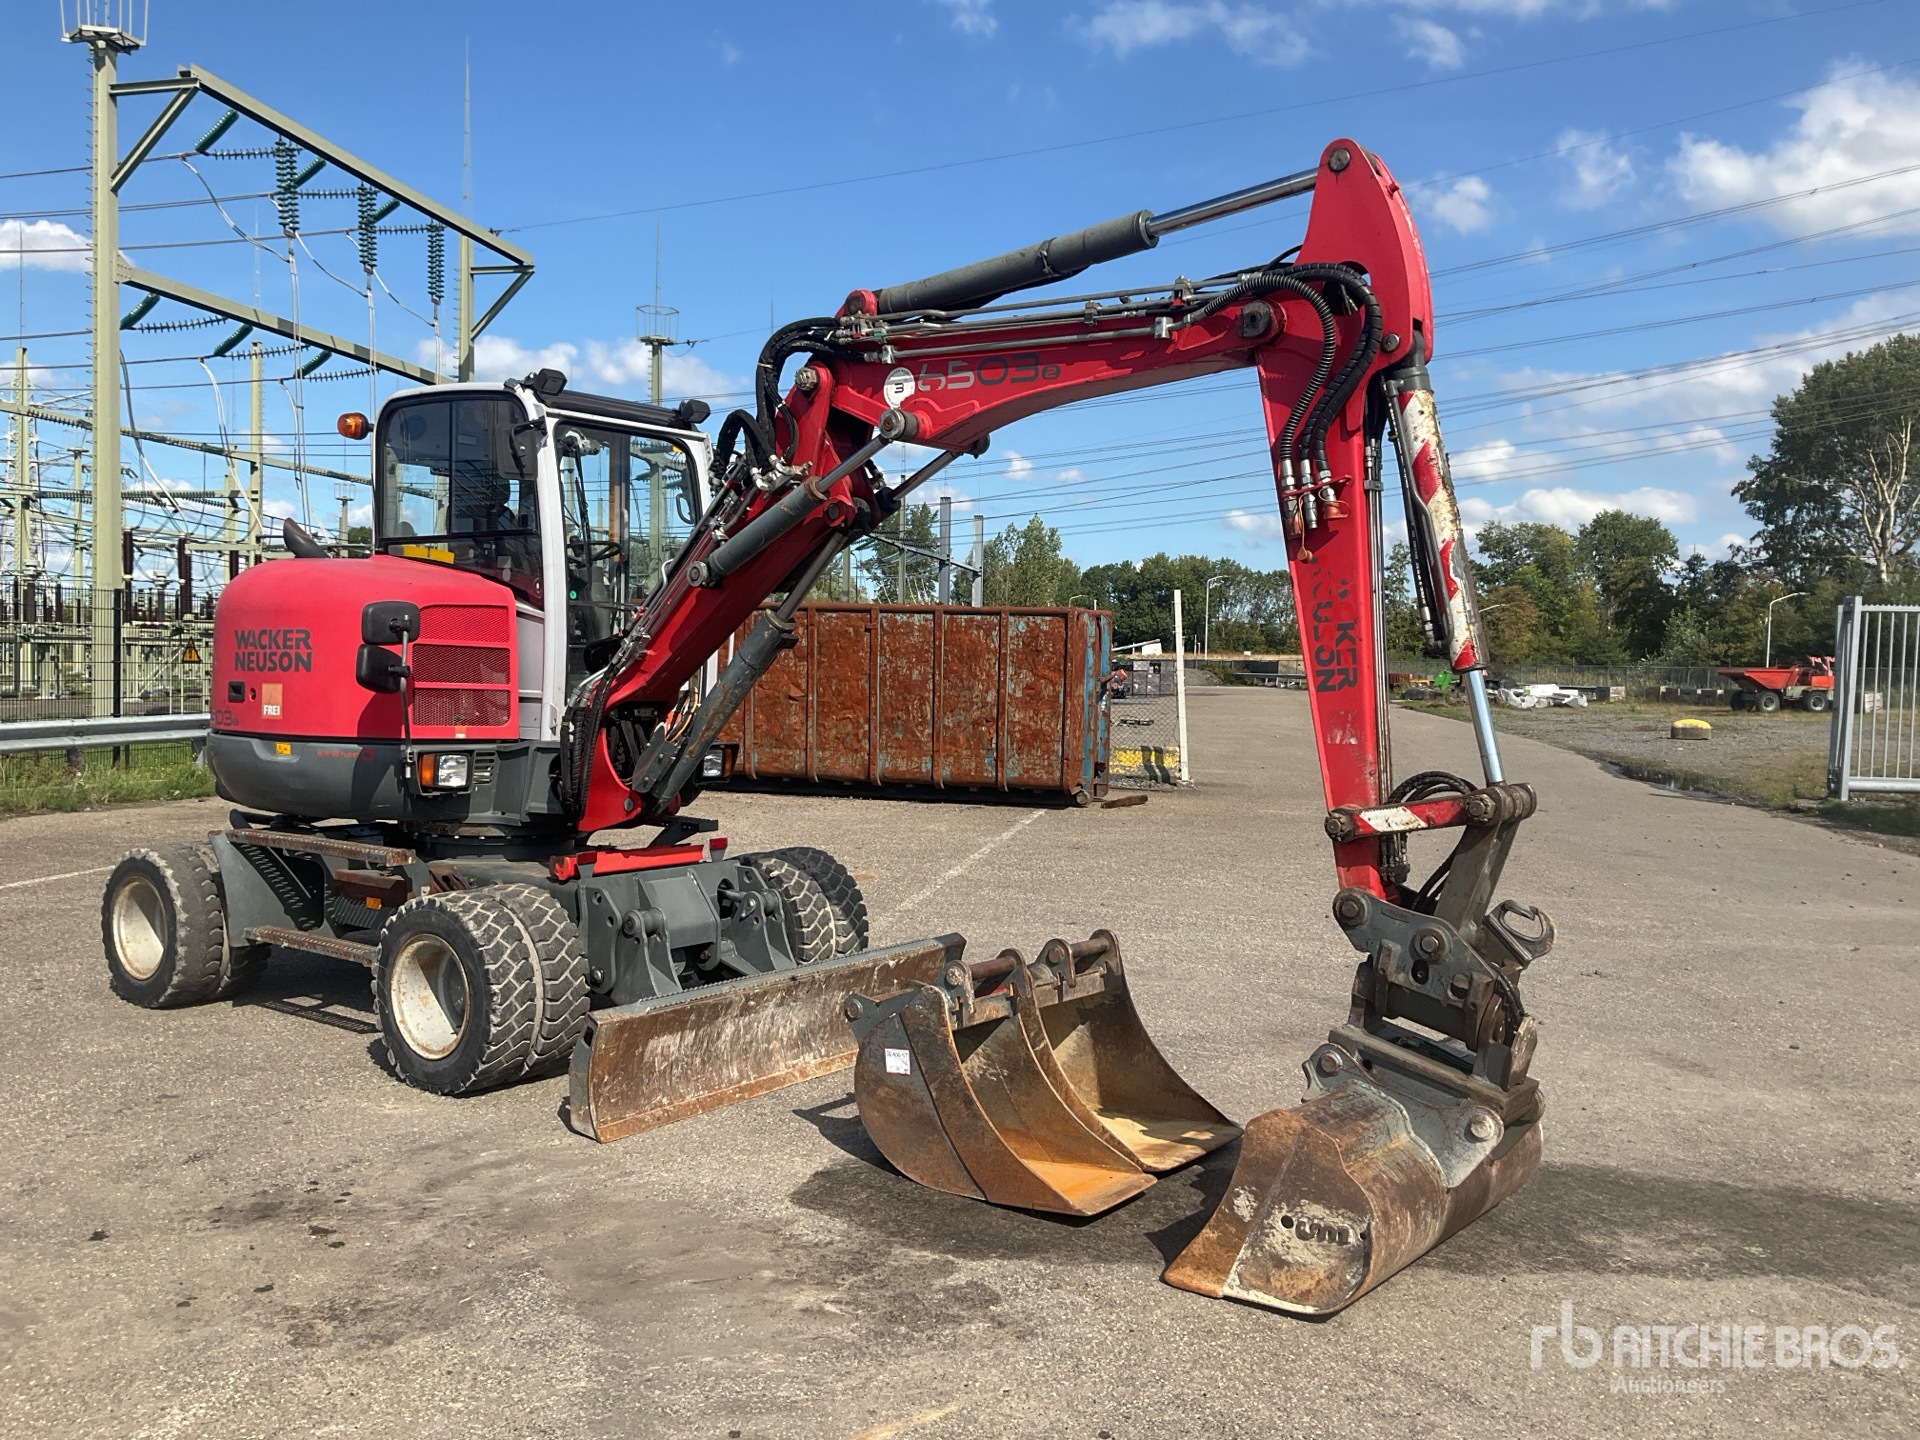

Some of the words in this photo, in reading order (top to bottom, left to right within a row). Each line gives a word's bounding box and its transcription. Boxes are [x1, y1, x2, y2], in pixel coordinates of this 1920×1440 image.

[235, 629, 313, 650] WACKER
[235, 651, 312, 672] NEUSON
[263, 705, 280, 716] FREI
